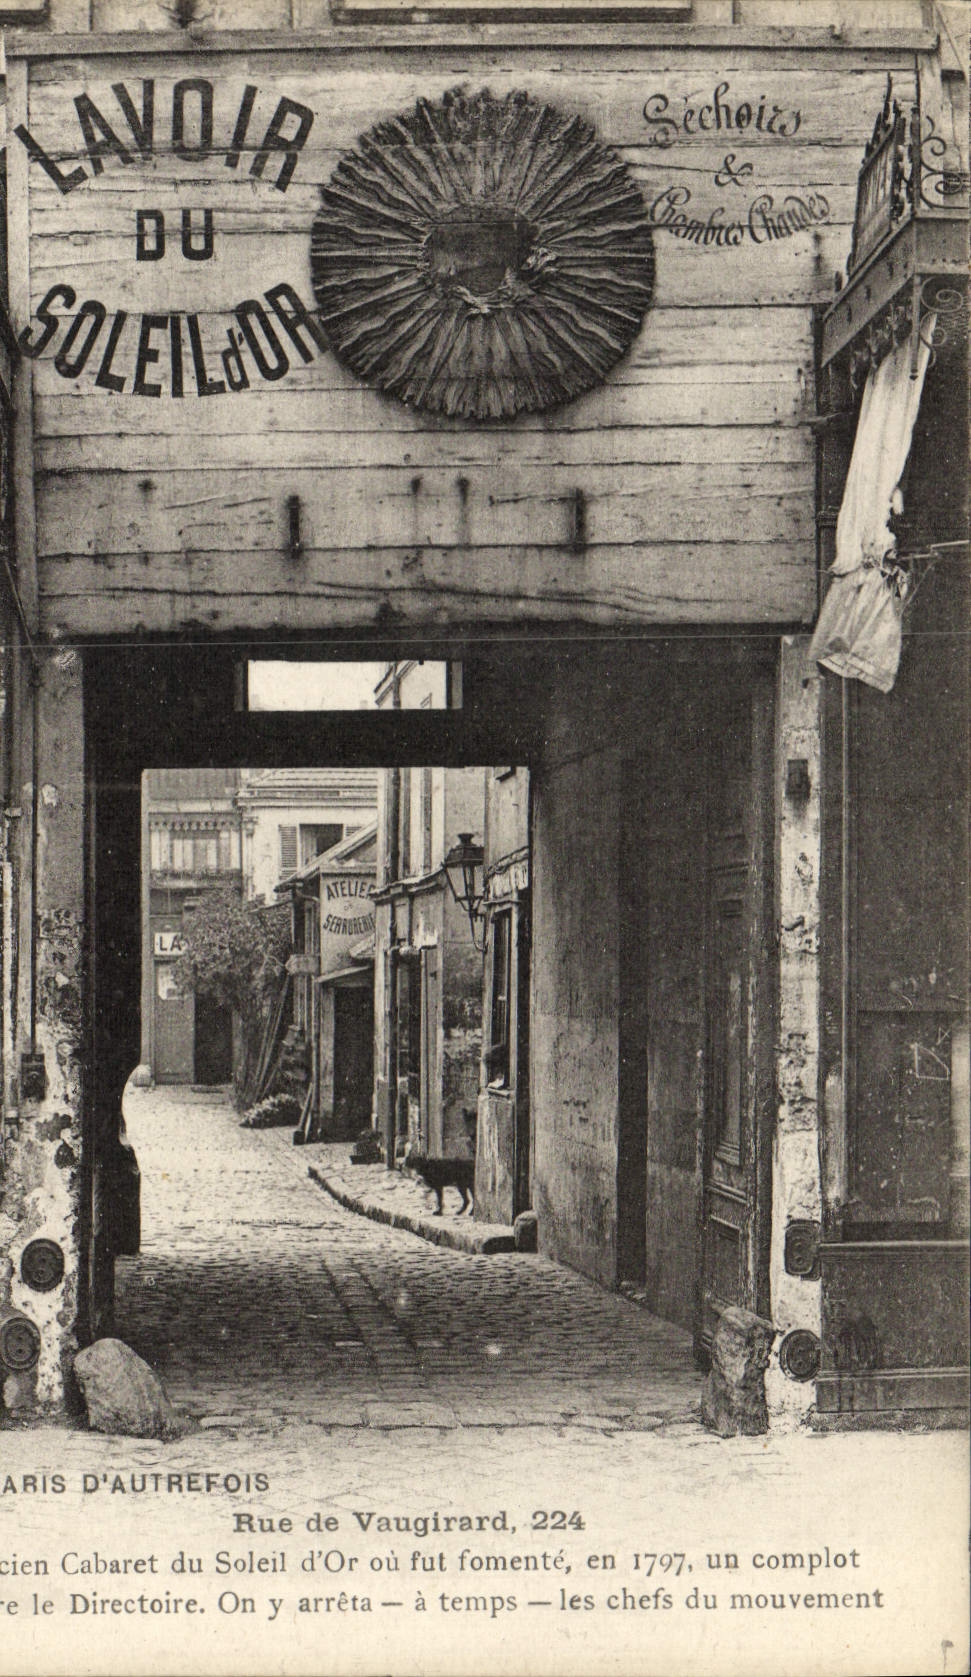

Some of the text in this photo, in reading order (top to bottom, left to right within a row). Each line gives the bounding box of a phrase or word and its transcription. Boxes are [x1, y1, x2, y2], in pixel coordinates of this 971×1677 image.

[14, 78, 314, 195] LAVOIR
[714, 153, 753, 187] &
[136, 208, 214, 261] DU
[17, 282, 331, 399] SOLEIL d'OR
